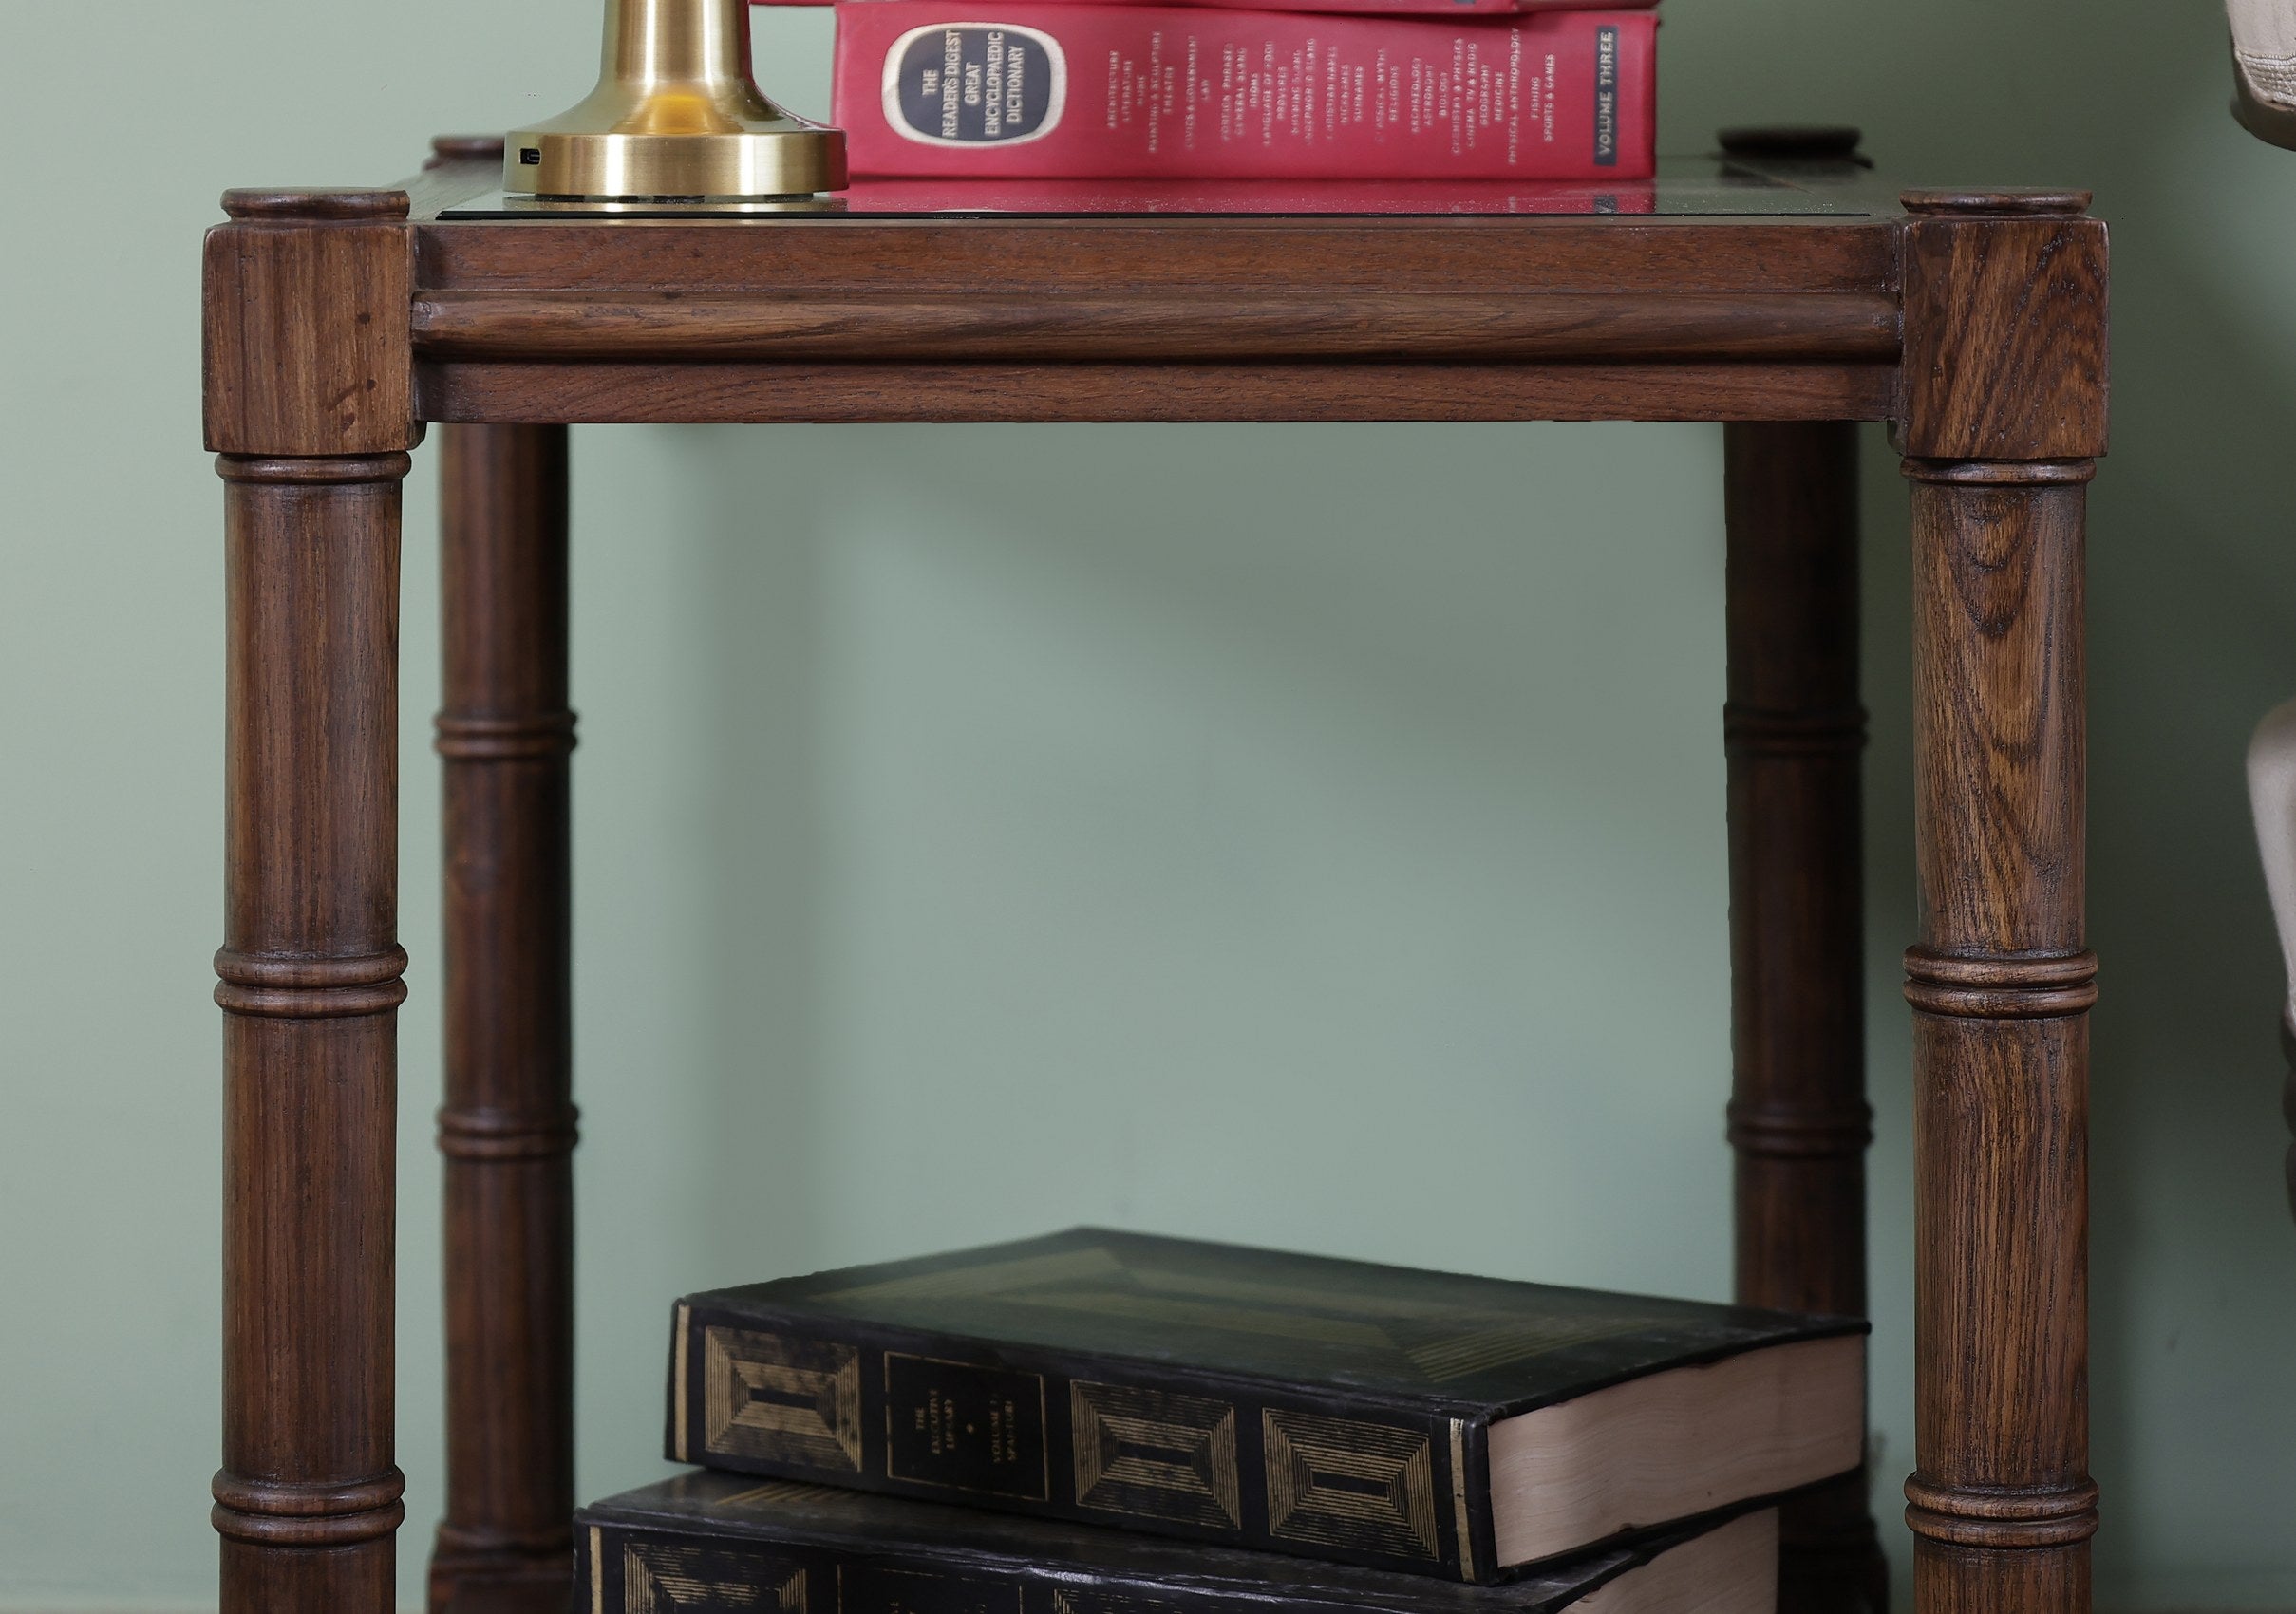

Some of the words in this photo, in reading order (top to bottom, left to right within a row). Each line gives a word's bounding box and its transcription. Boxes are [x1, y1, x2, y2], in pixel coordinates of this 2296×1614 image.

[945, 30, 961, 76] DIGEST
[1510, 28, 1521, 111] ANTHROPOLOGY
[1545, 54, 1556, 89] GAMES
[1599, 31, 1613, 85] THREE
[922, 69, 937, 95] THE
[965, 62, 980, 104] GREAT
[986, 32, 1003, 135] ENCYCLOPAEDIC
[1007, 46, 1024, 123] DICTIONARY
[1107, 50, 1119, 129] ARCHITECTURE
[1438, 71, 1448, 118] BIOLOGY
[1479, 64, 1490, 127] GEOGRAPHY
[1495, 71, 1504, 122] MEDICINE
[1531, 76, 1540, 120] FISHING
[1508, 114, 1519, 164] PHYSICAL
[1544, 103, 1554, 141] SPORTS
[1598, 91, 1612, 155] VOLUME
[914, 1407, 926, 1431] THE
